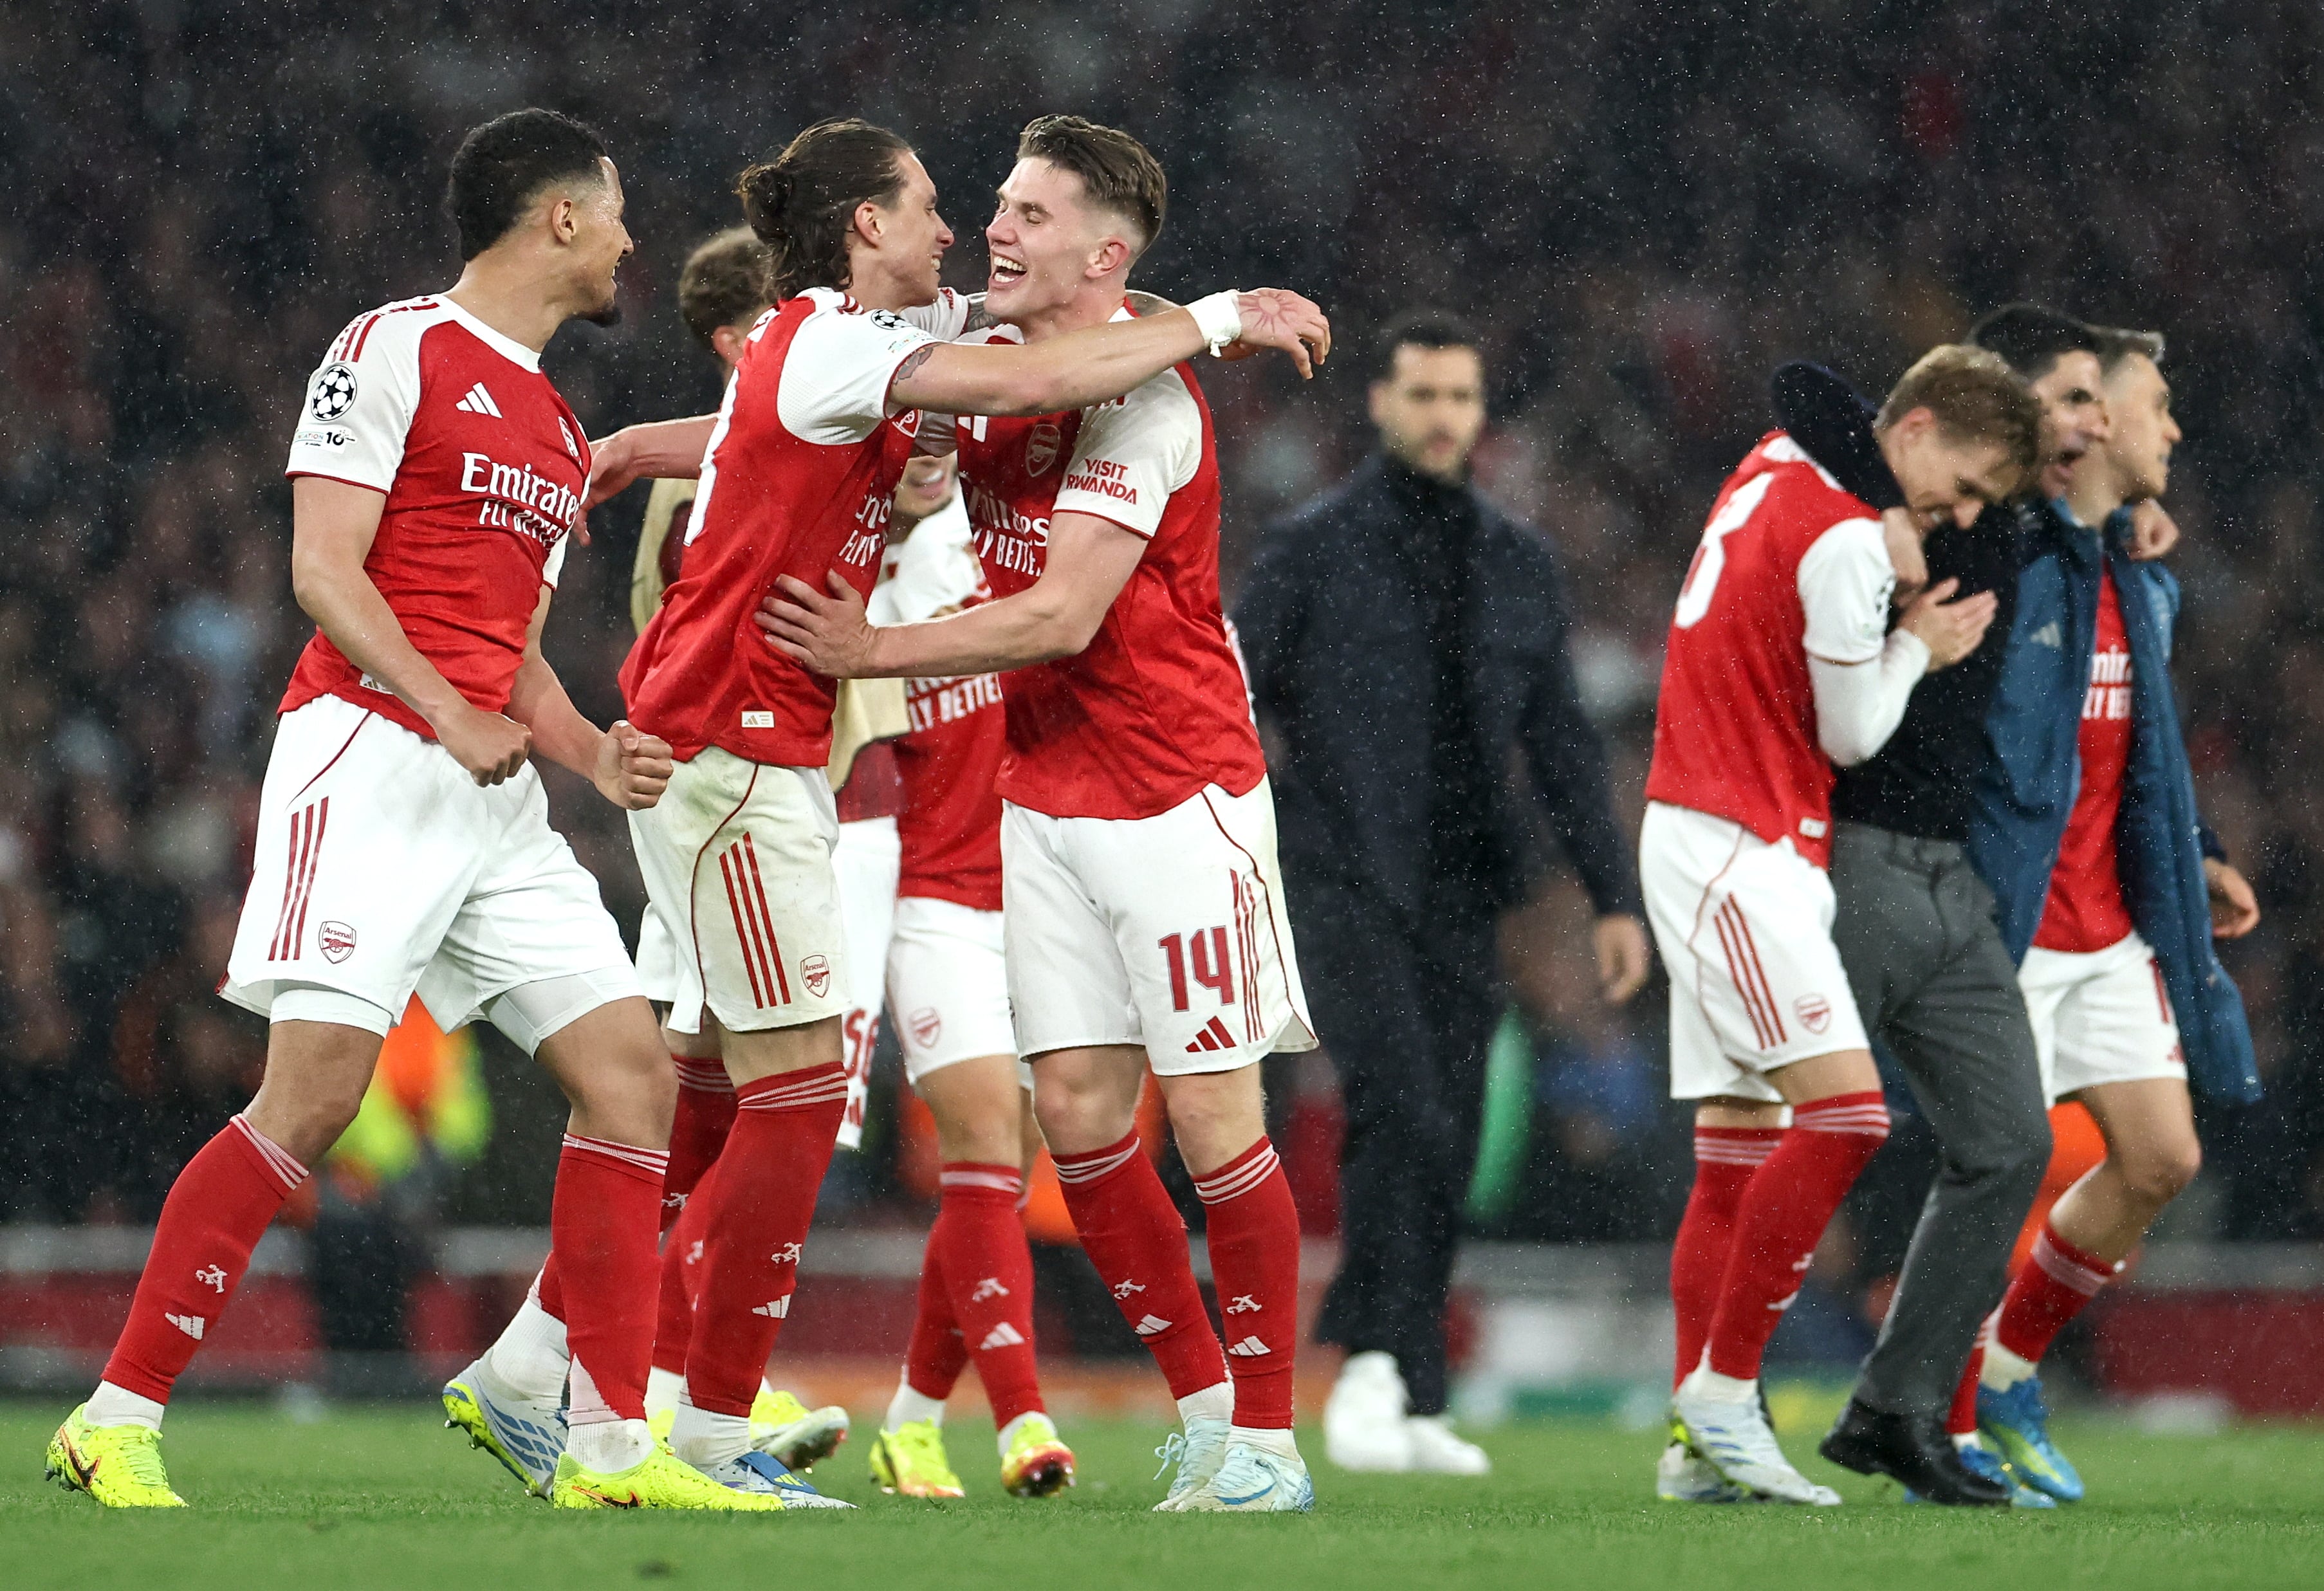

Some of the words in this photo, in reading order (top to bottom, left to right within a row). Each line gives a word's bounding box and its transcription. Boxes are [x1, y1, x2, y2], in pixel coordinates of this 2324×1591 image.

[1084, 457, 1129, 481] VISIT
[1065, 474, 1138, 505] RWANDA
[324, 926, 351, 939] Arsenal
[1157, 924, 1235, 1013] 14
